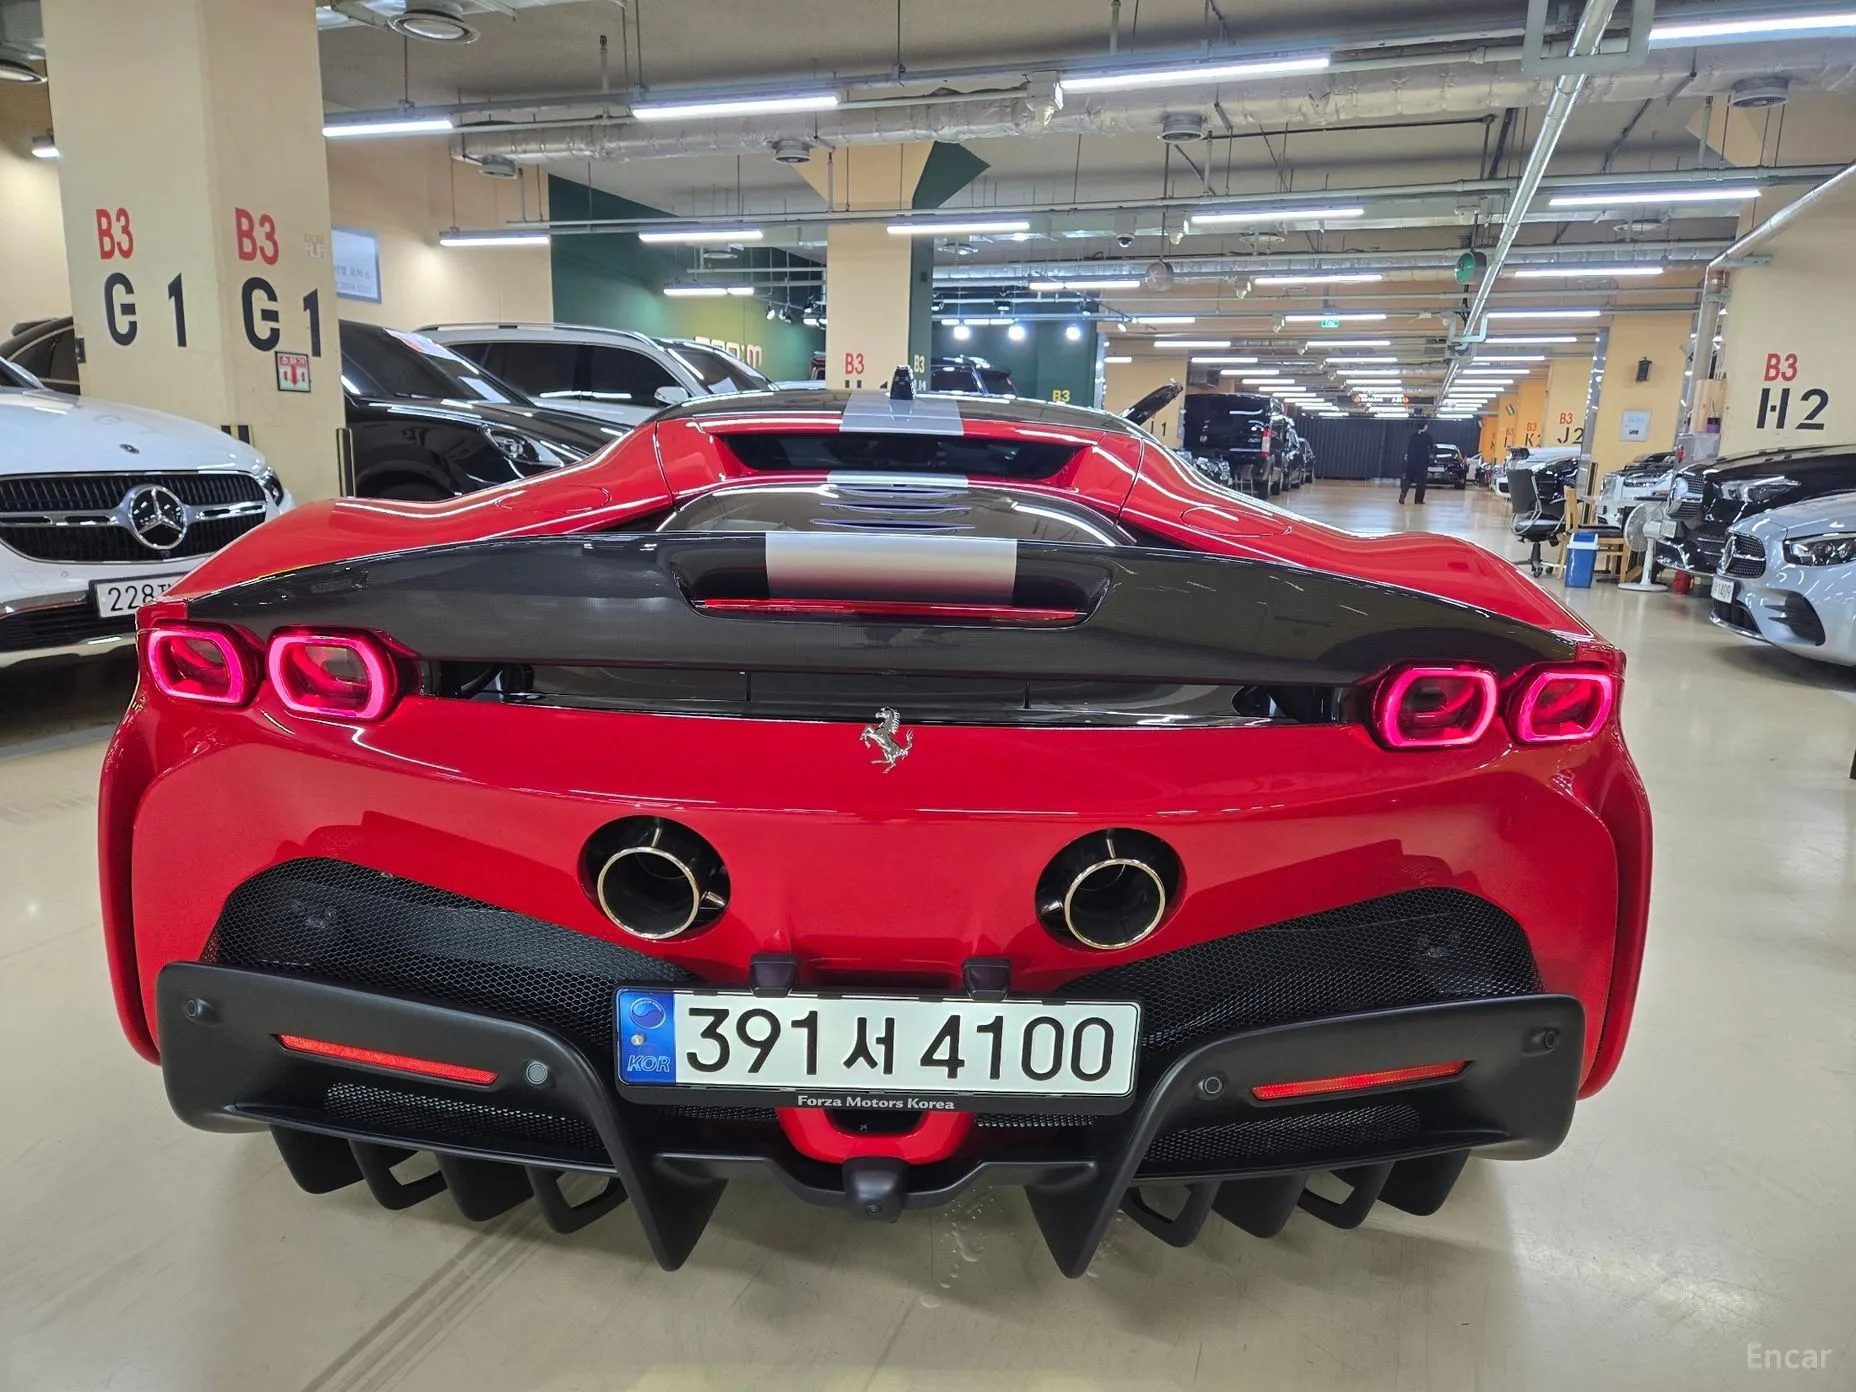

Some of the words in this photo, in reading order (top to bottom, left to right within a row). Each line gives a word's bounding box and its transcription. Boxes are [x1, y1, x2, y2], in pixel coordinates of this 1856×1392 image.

[96, 208, 134, 260] B3
[235, 207, 279, 265] B3
[845, 353, 864, 375] B3
[914, 355, 925, 373] B3
[1764, 353, 1798, 381] B3
[1052, 390, 1070, 402] B3
[1560, 412, 1573, 424] B3
[1527, 423, 1538, 432] B3
[920, 1014, 1115, 1082] 4100
[627, 1055, 671, 1072] KOR
[798, 1096, 842, 1107] Forza
[846, 1097, 904, 1109] Motors
[908, 1098, 955, 1110] Korea
